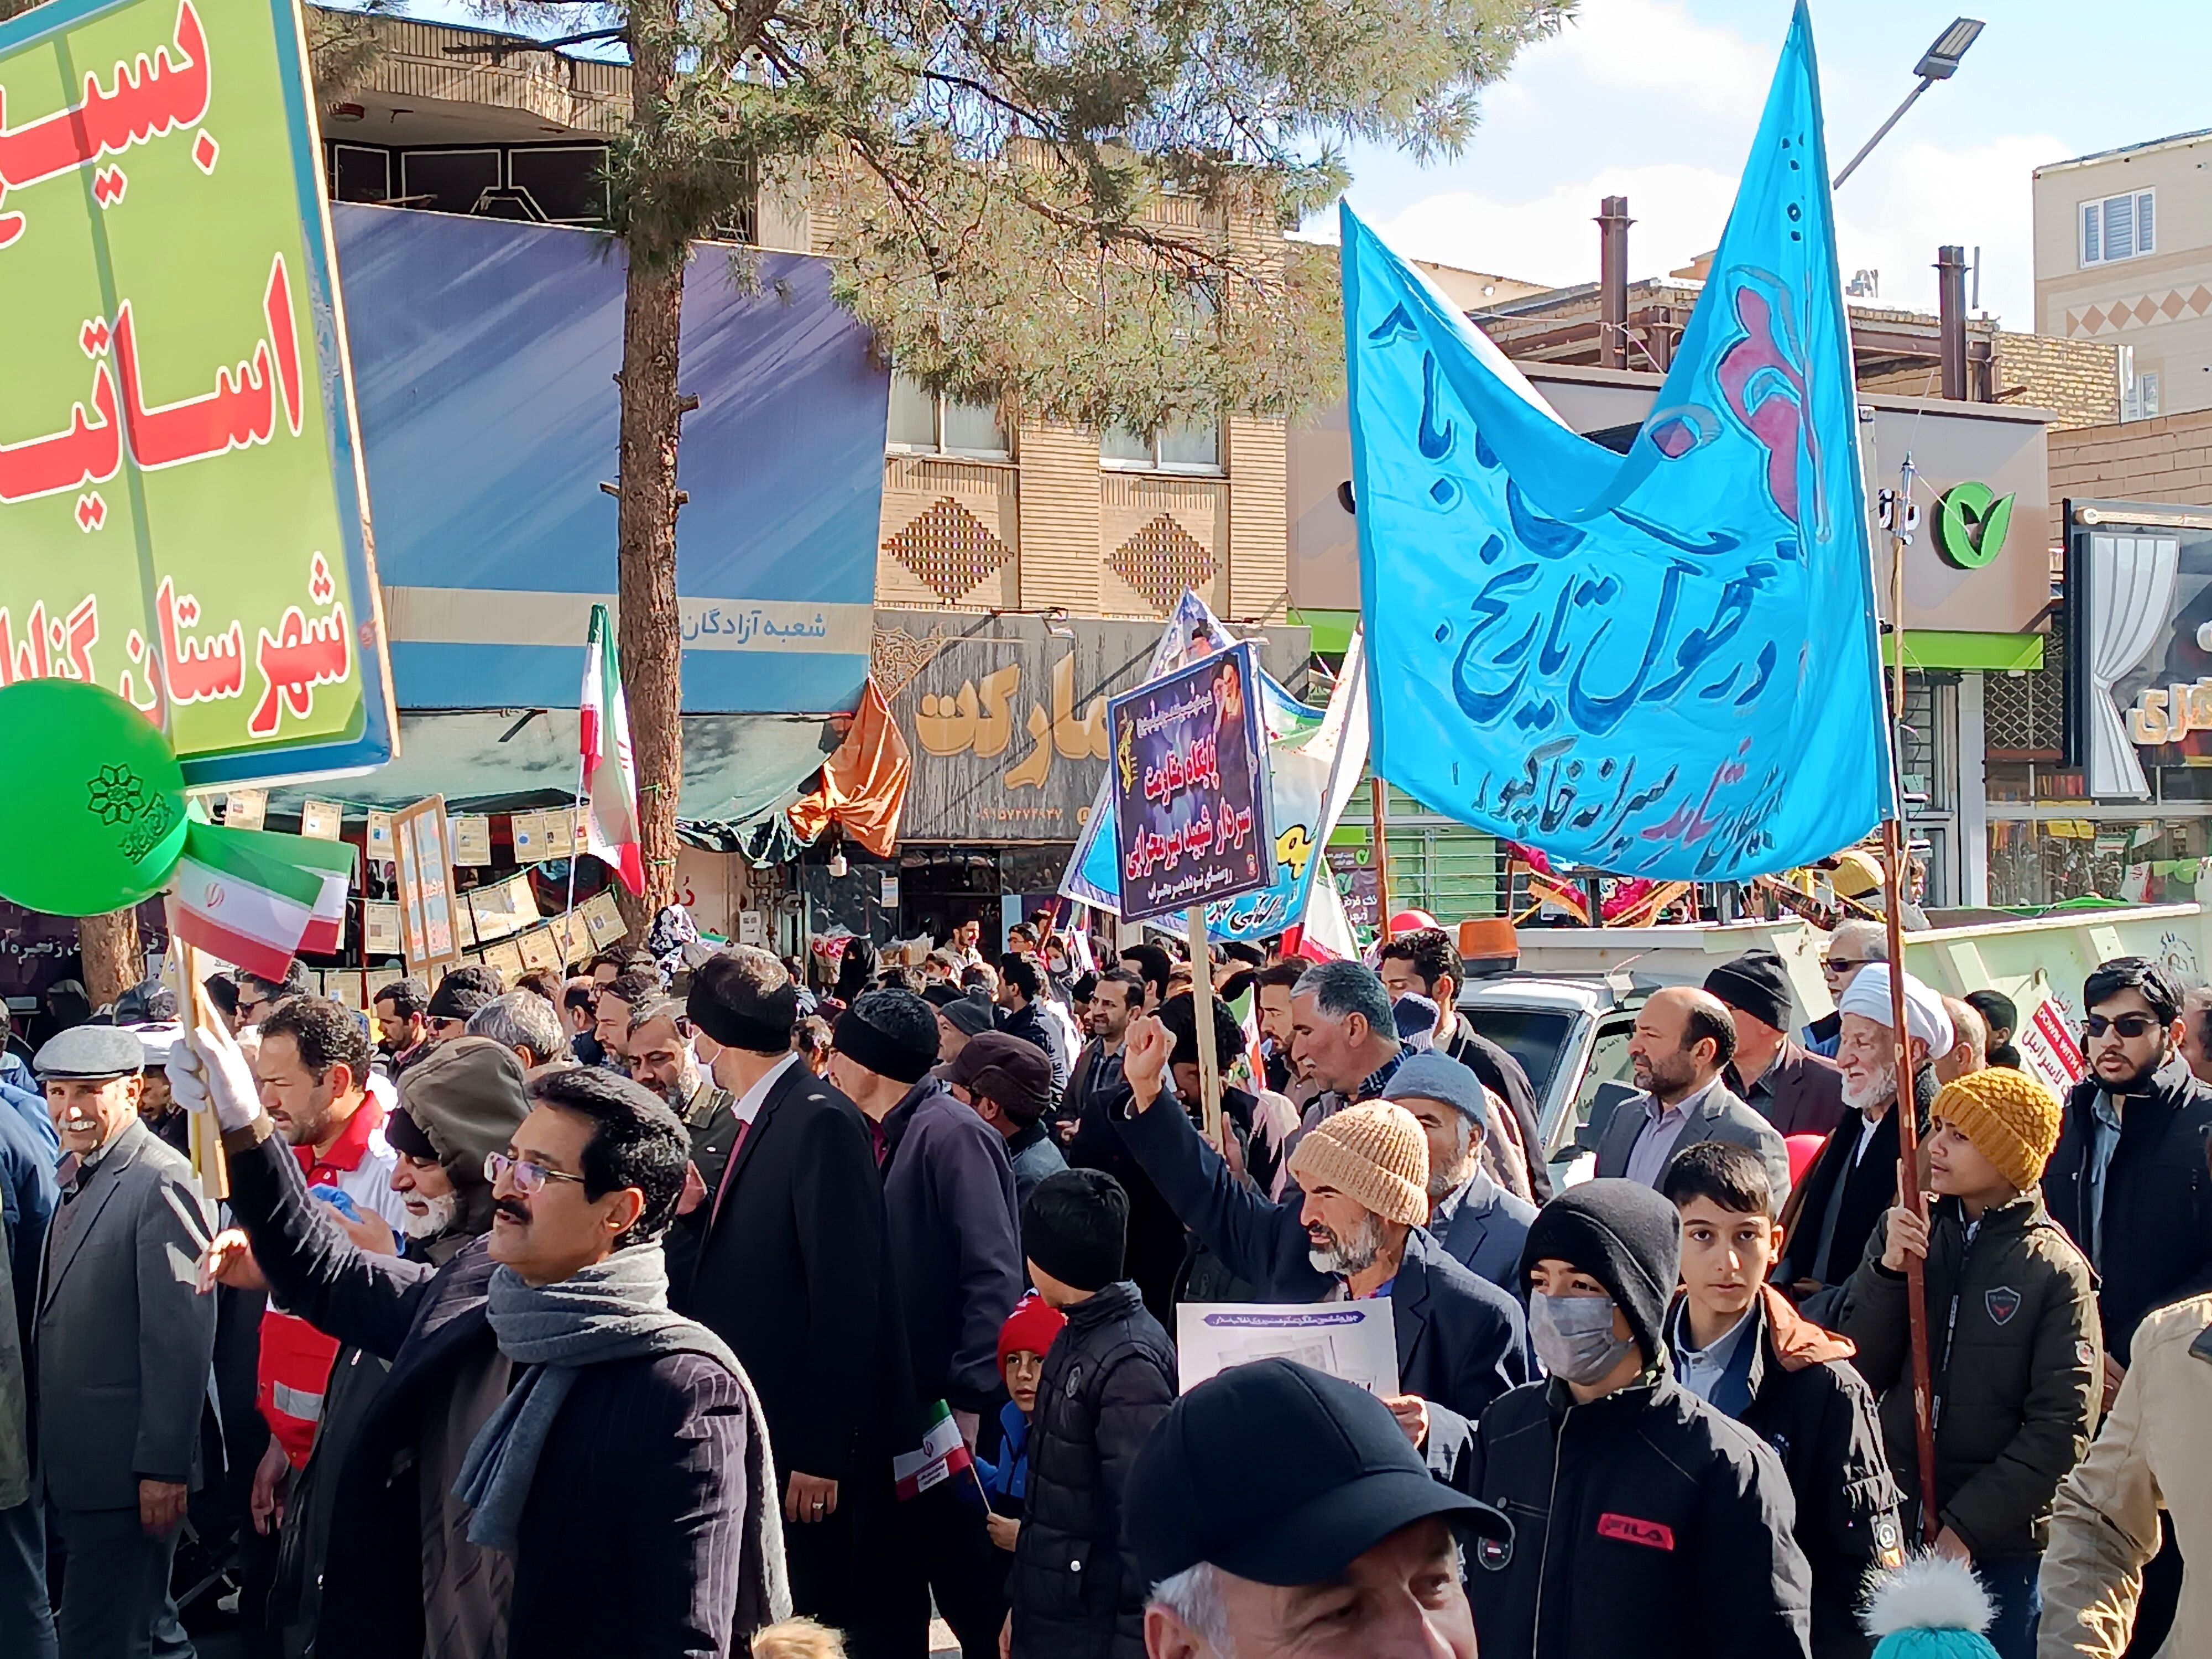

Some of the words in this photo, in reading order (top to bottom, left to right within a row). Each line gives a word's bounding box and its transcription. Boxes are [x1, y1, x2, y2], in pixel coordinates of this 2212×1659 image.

[0, 0, 219, 249] بسی
[0, 252, 303, 534] اساتی
[681, 607, 762, 644] آزادگان
[763, 613, 826, 643] شعبه
[1452, 533, 1619, 732] تاریخ
[1568, 556, 1778, 737] طول
[1698, 640, 1777, 706] در
[1183, 804, 1213, 860] شهید
[1215, 795, 1251, 855] سردار
